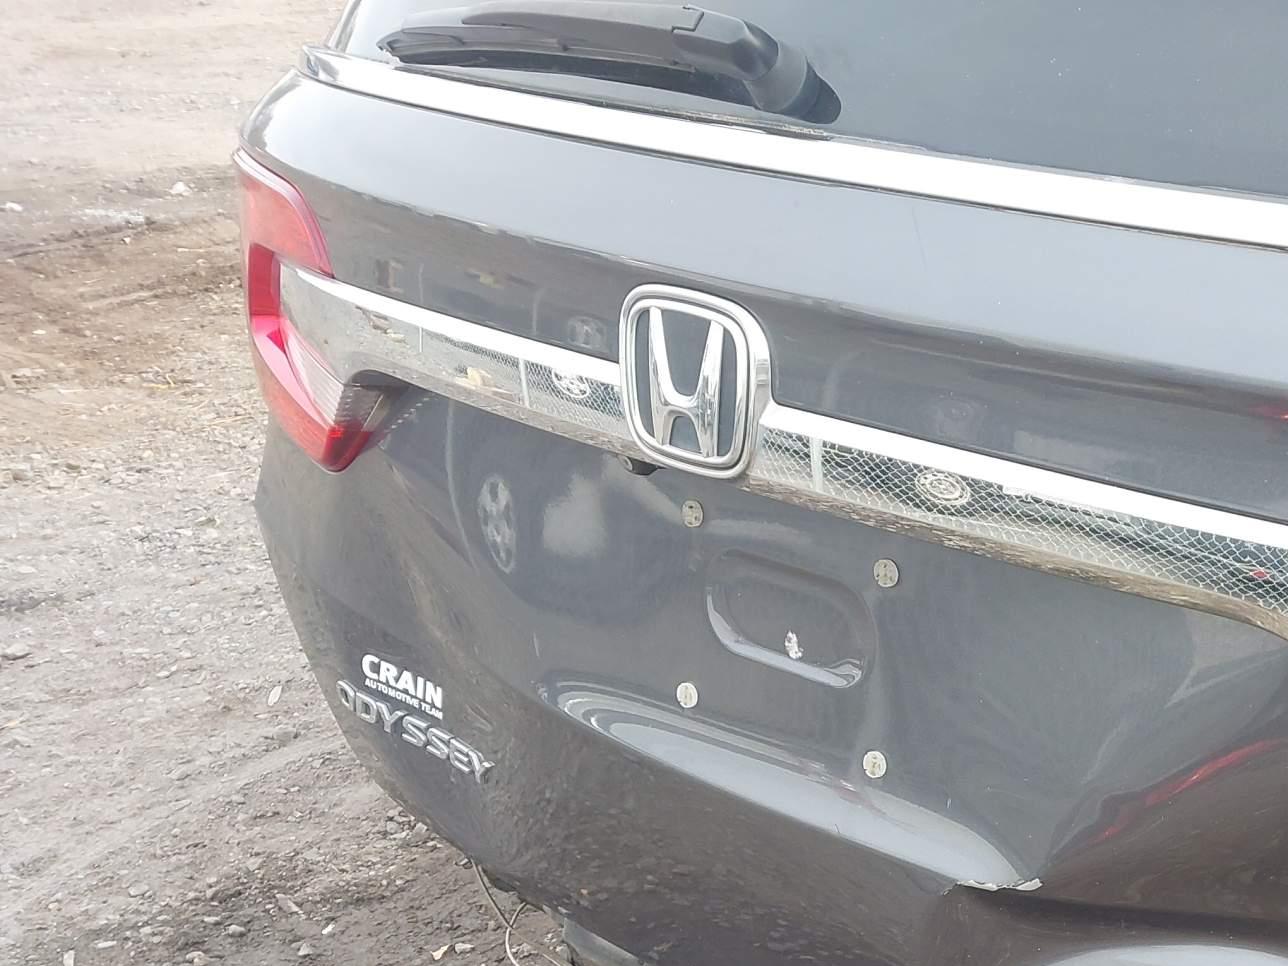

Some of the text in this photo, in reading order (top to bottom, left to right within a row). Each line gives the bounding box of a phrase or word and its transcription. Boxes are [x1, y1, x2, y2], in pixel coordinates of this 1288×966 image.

[361, 654, 443, 709] CRAIN
[364, 678, 443, 720] AUTOMOTIVE TEAM
[336, 680, 495, 784] ODYSSEY
